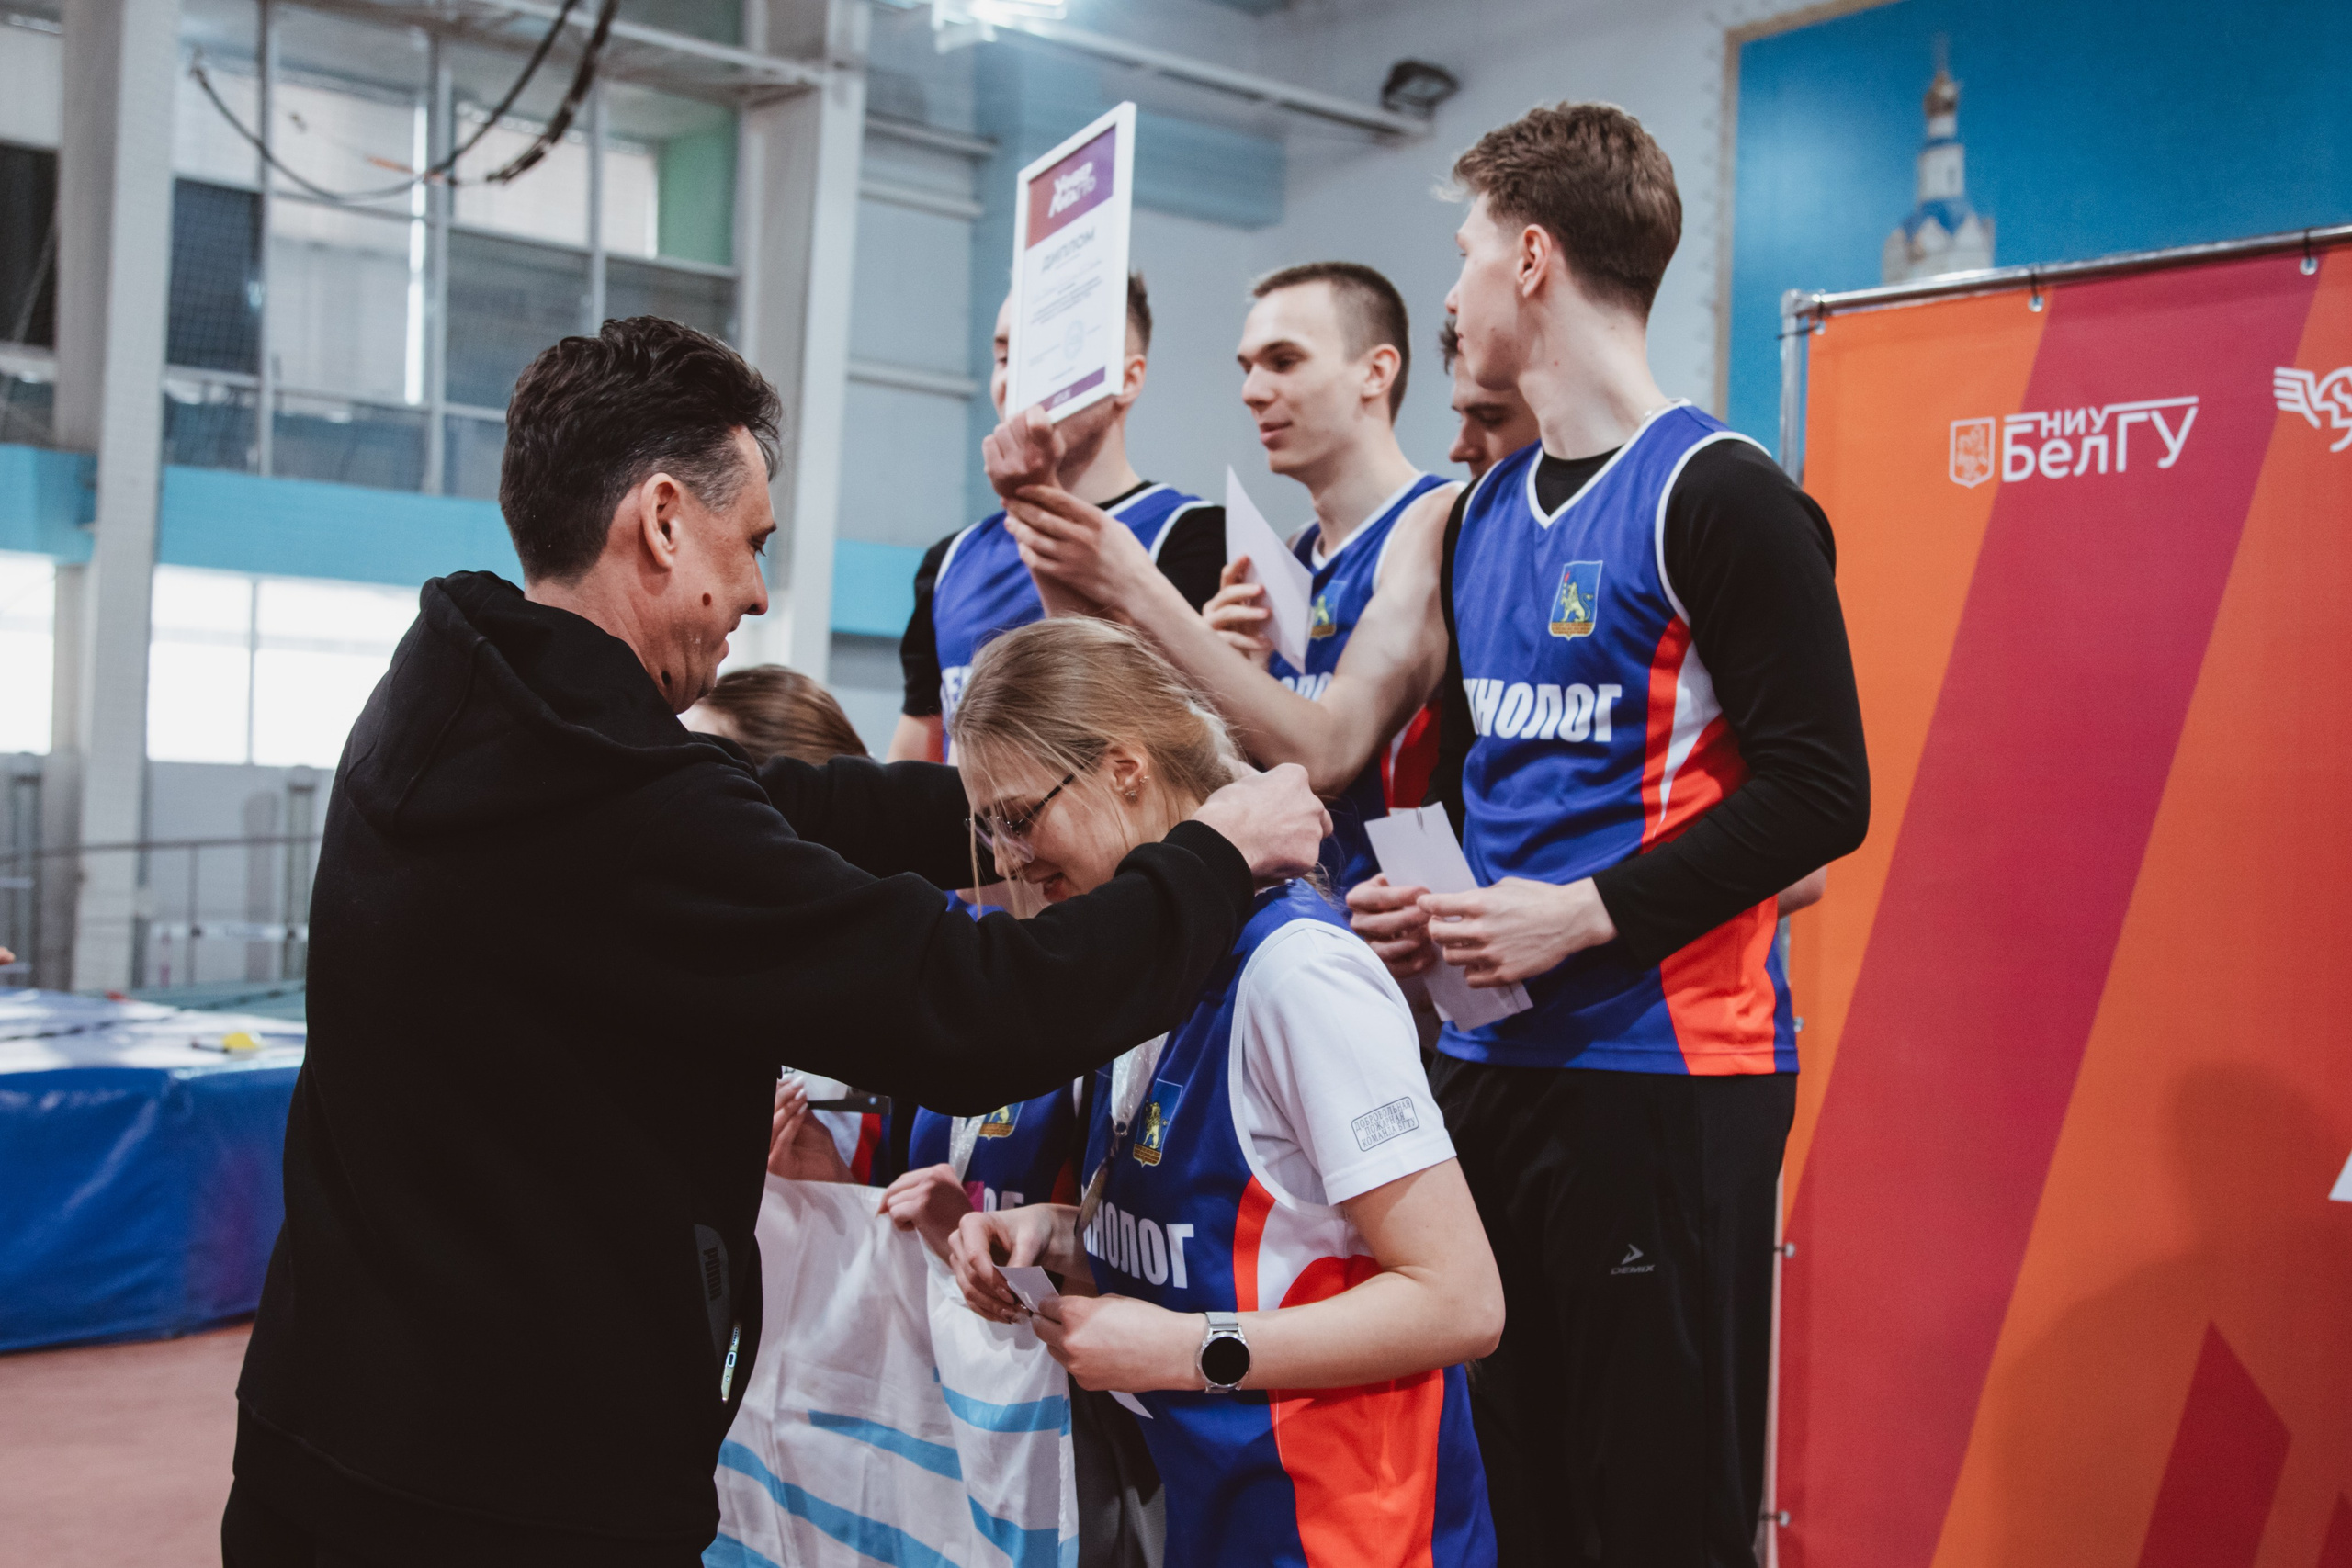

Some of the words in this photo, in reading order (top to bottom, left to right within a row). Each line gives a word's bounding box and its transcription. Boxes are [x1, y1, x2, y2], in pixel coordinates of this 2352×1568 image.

[2041, 406, 2109, 438] НИУ
[2001, 404, 2199, 483] БелГУ
[1361, 1126, 1398, 1148] КОМАНДА
[1364, 1111, 1406, 1136] ПОЖАРНАЯ
